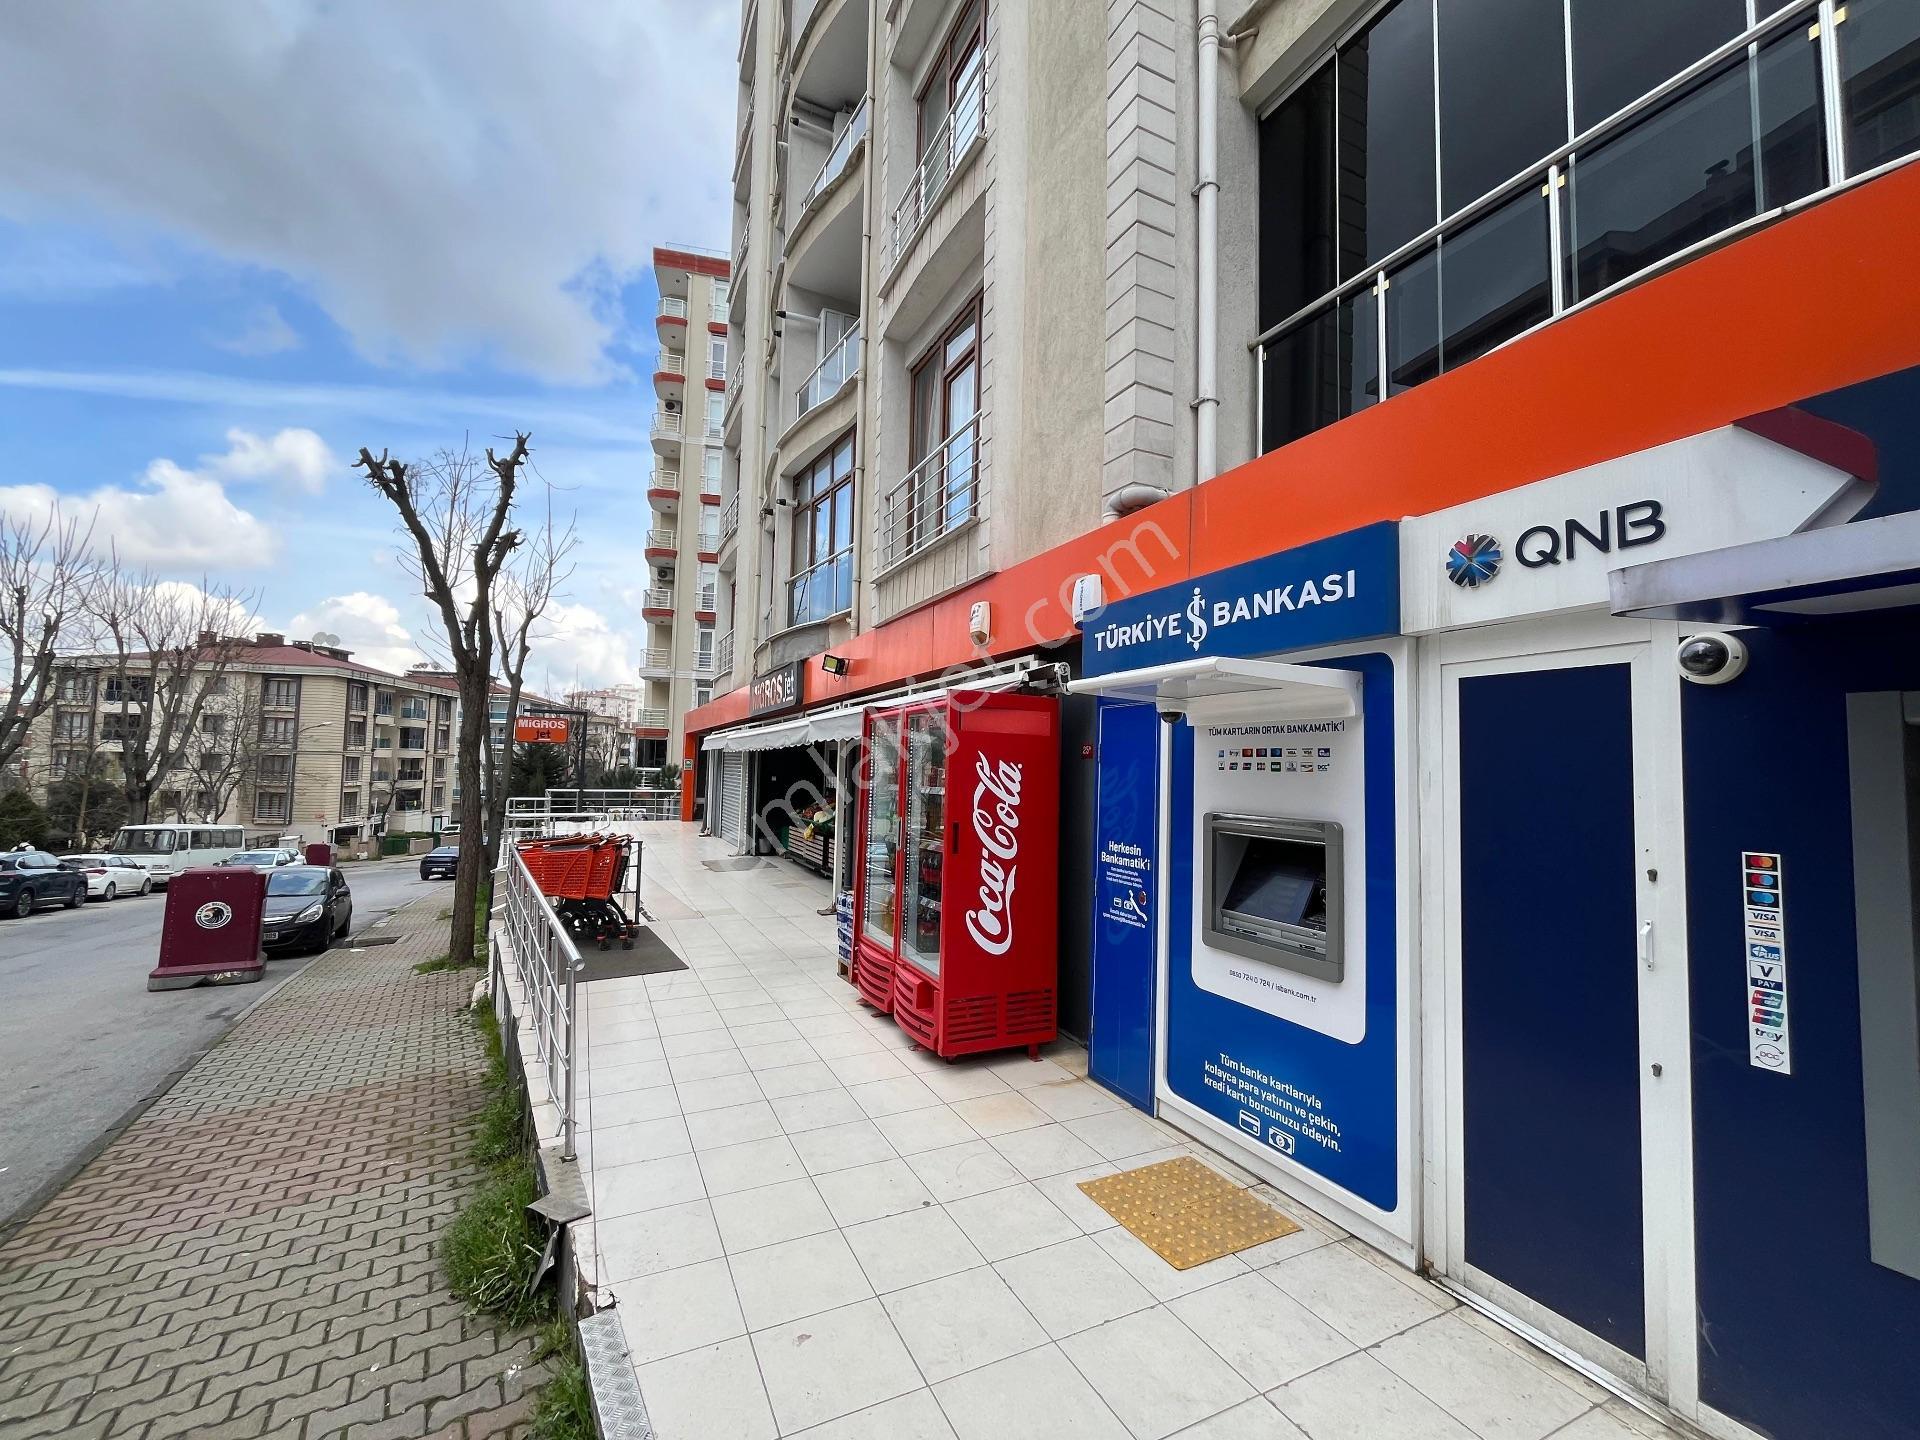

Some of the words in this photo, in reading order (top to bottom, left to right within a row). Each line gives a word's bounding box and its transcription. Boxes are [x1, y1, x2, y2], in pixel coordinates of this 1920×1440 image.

[1515, 500, 1666, 568] QNB
[1094, 612, 1181, 651] TÜRKİYE
[1212, 570, 1356, 627] BANKASI
[536, 730, 550, 739] jet
[1208, 726, 1222, 736] TÜM
[1223, 726, 1260, 735] KARTLARIN
[1262, 725, 1286, 734] ORTAK
[965, 751, 1023, 956] Coca-Cola
[1108, 841, 1142, 856] Herkesin
[1752, 912, 1776, 921] VISA
[1754, 930, 1776, 938] VISA
[1205, 1061, 1237, 1084] kolayca
[1239, 1078, 1259, 1096] para
[1261, 1087, 1293, 1113] yatırın
[1295, 1103, 1307, 1119] ve
[1308, 1112, 1341, 1137] çekin,
[1220, 1052, 1238, 1071] Tüm
[1240, 1063, 1268, 1084] banka
[1270, 1076, 1321, 1109] kartlarıyla
[1205, 1074, 1225, 1093] kredi
[1227, 1086, 1247, 1104] kartı
[1249, 1096, 1299, 1131] borcunuzu
[1302, 1122, 1341, 1152] ödeyin.
